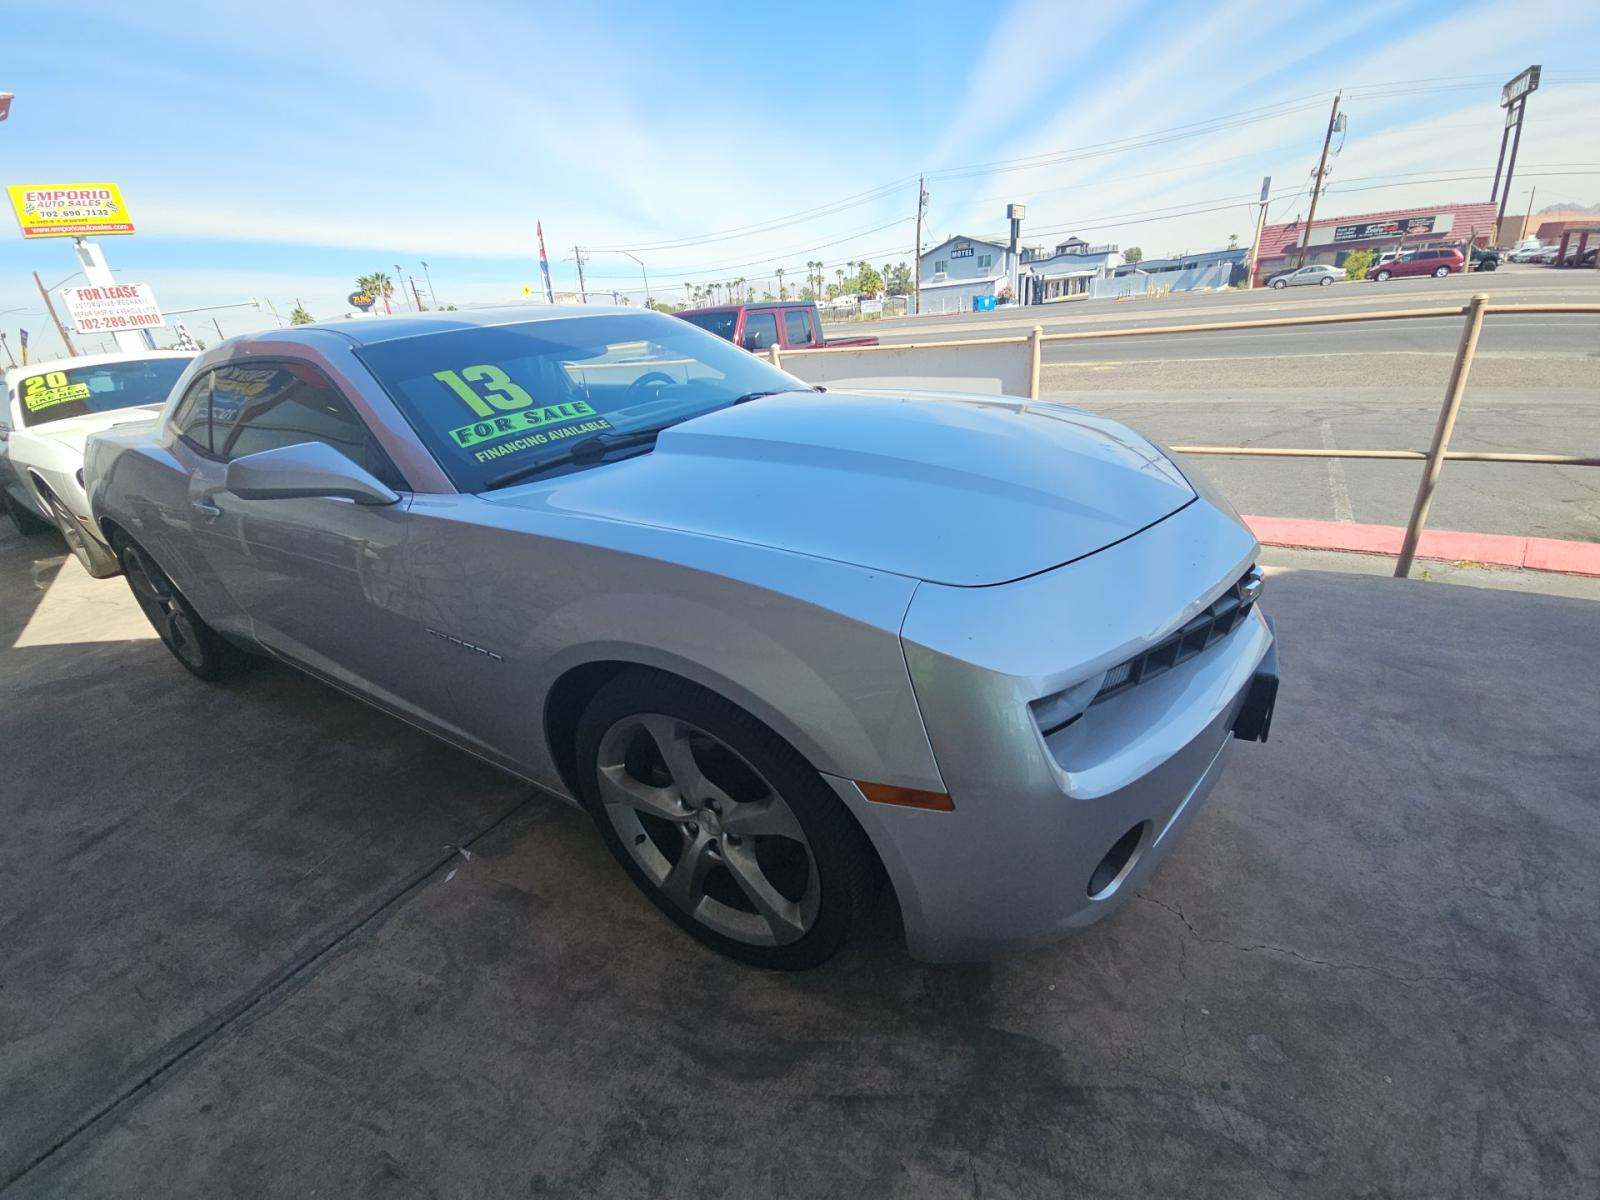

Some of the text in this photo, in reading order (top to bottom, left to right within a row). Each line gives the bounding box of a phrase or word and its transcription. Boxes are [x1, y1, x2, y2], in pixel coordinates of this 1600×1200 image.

[26, 190, 110, 201] EMPORIO
[952, 249, 973, 257] MOTEL
[76, 286, 140, 300] FOR LEASE
[77, 314, 161, 330] 702-289-0800
[25, 371, 68, 395] 20
[432, 364, 534, 418] 13
[58, 388, 85, 401] NEW
[455, 402, 590, 445] FOR SALE
[474, 420, 612, 463] FINANCING AVAILABLE
